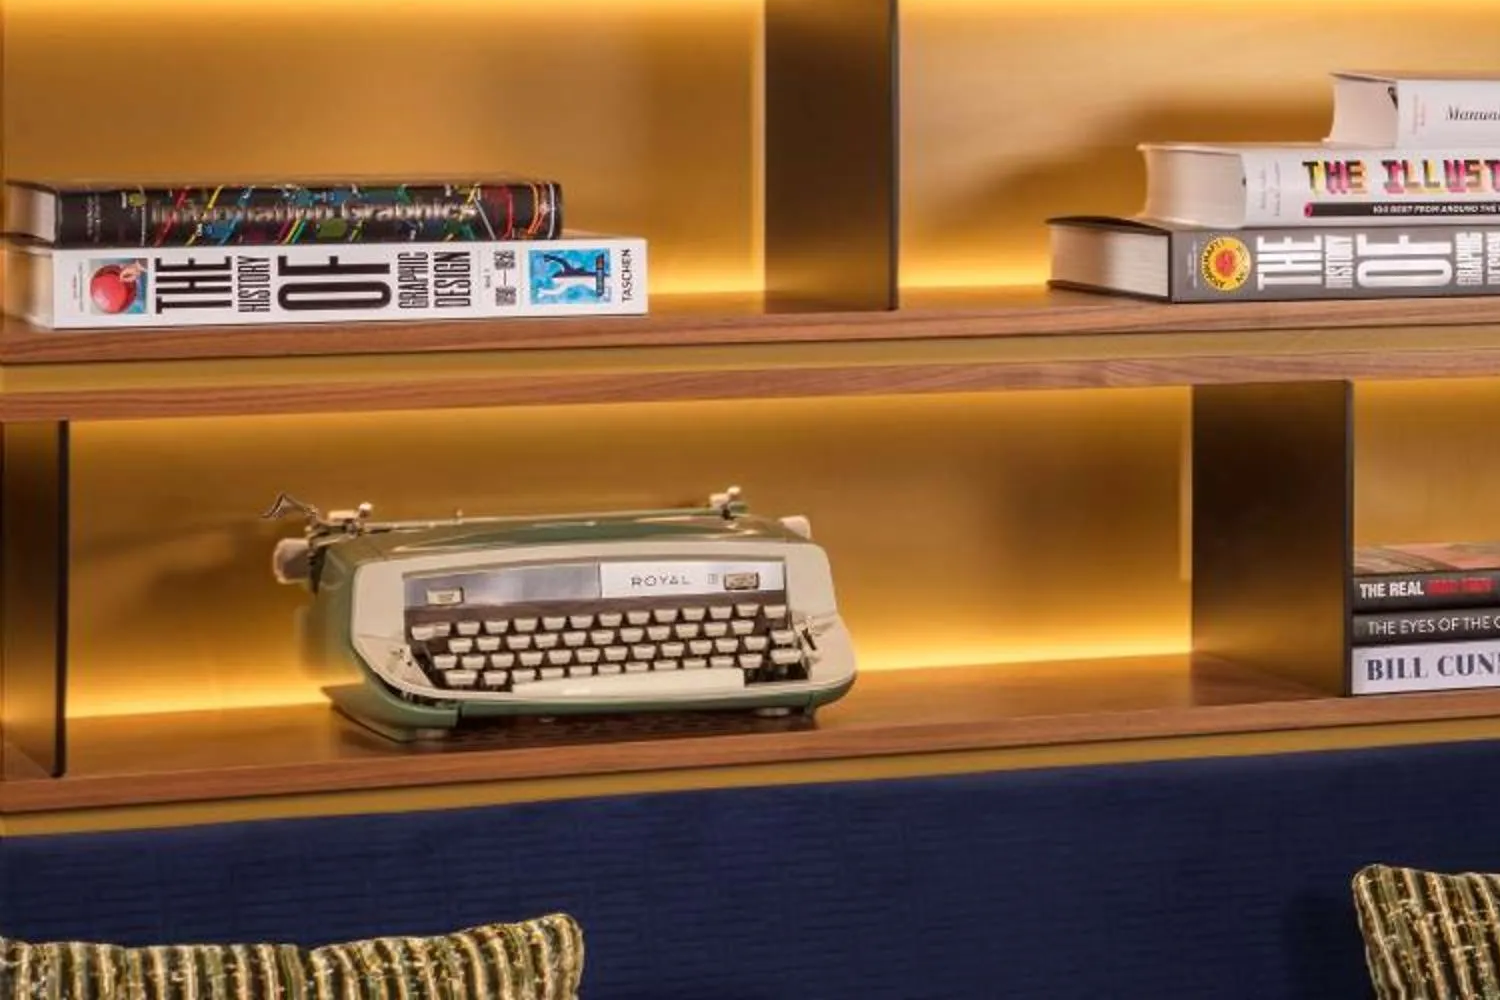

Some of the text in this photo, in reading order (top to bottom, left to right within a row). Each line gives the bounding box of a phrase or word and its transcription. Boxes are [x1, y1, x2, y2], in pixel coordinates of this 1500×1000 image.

[1302, 159, 1367, 195] THE
[154, 255, 233, 314] THE
[237, 255, 271, 313] HISTORY
[278, 254, 393, 312] OF
[397, 251, 430, 309] GRAPHIC
[434, 251, 472, 308] DESIGN
[621, 248, 632, 302] TASCHEN
[1257, 235, 1322, 291] THE
[1356, 233, 1453, 288] OF
[630, 575, 690, 588] ROYAL
[1360, 583, 1386, 598] THE
[1389, 581, 1425, 597] REAL
[1368, 621, 1396, 636] THE
[1400, 619, 1436, 634] EYES
[1438, 617, 1460, 632] OF
[1463, 616, 1491, 631] THE
[1367, 656, 1429, 681] BILL
